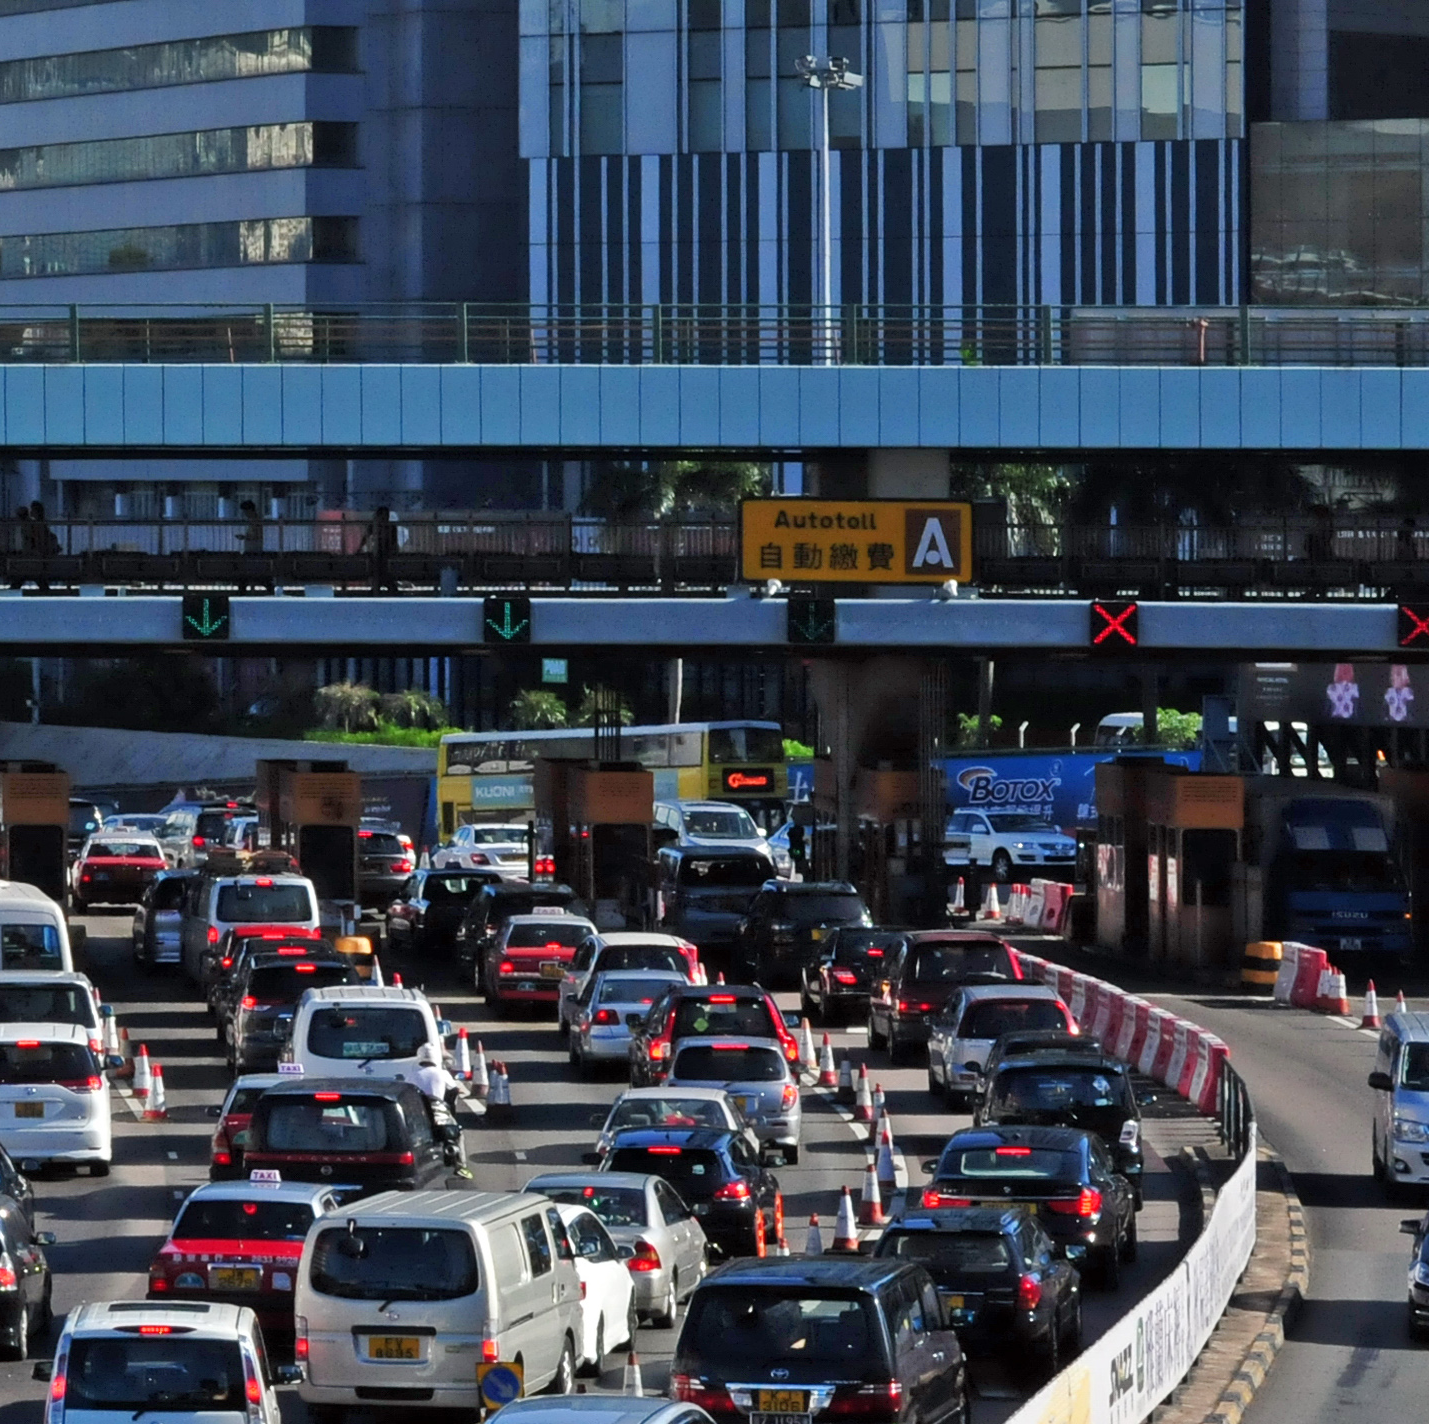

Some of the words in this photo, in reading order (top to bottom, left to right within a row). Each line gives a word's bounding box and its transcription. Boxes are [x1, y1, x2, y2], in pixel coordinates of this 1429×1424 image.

[774, 510, 877, 530] Autotoll
[760, 543, 895, 571] 自動繳費
[253, 1171, 277, 1180] TAXI
